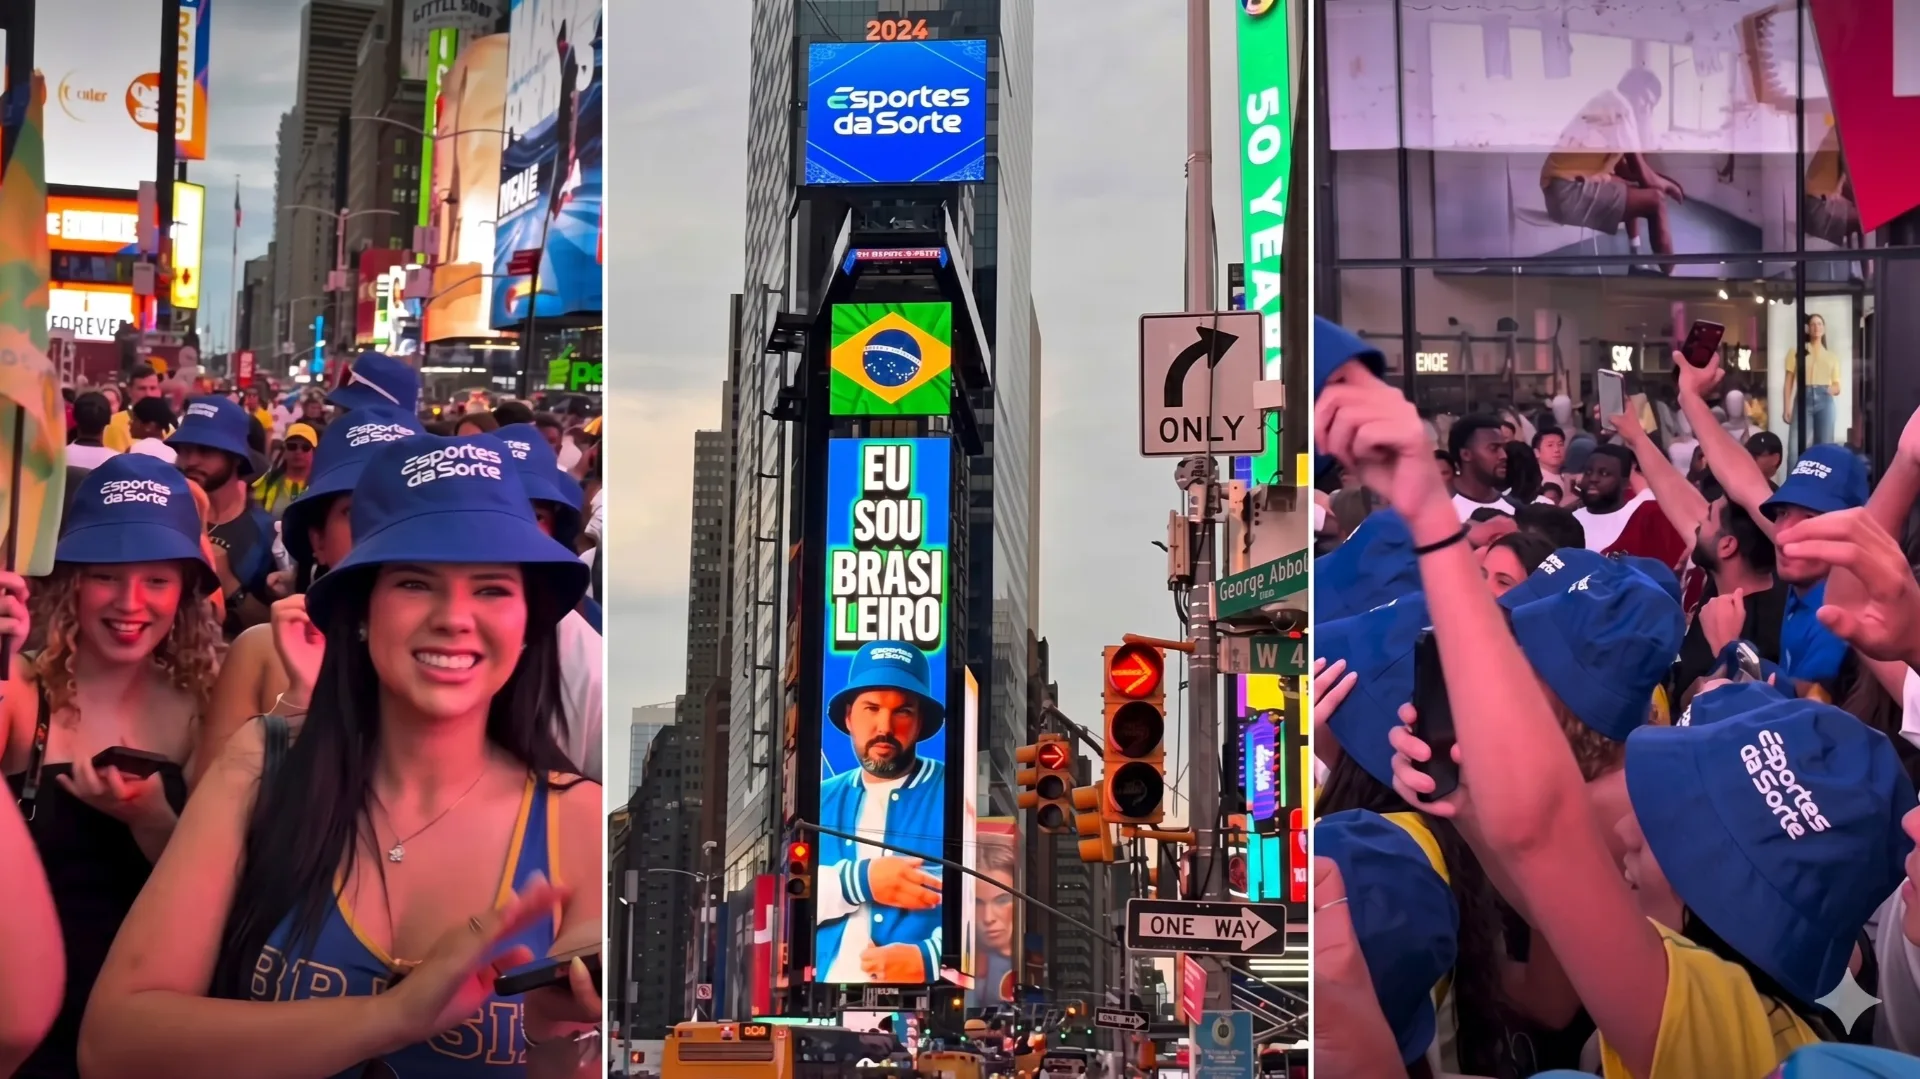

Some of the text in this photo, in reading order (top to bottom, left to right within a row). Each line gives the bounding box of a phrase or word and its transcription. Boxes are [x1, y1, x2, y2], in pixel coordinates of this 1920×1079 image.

[866, 19, 928, 41] 2024
[827, 85, 970, 114] Esportes
[833, 111, 962, 135] da Sorte
[1246, 86, 1281, 165] 50
[1159, 415, 1244, 443] ONLY
[401, 444, 502, 475] Esportes
[864, 445, 911, 491] EU
[100, 479, 171, 495] Esportes
[407, 461, 502, 487] da Sorte
[103, 490, 168, 506] da Sorte
[854, 499, 922, 542] SOU
[832, 550, 942, 595] BRASI
[1219, 574, 1265, 601] George
[835, 597, 940, 641] LEIRO
[1256, 643, 1278, 668] W
[1758, 729, 1831, 832] Esportes
[1752, 769, 1805, 840] Sorte
[1150, 916, 1260, 939] ONE WAY
